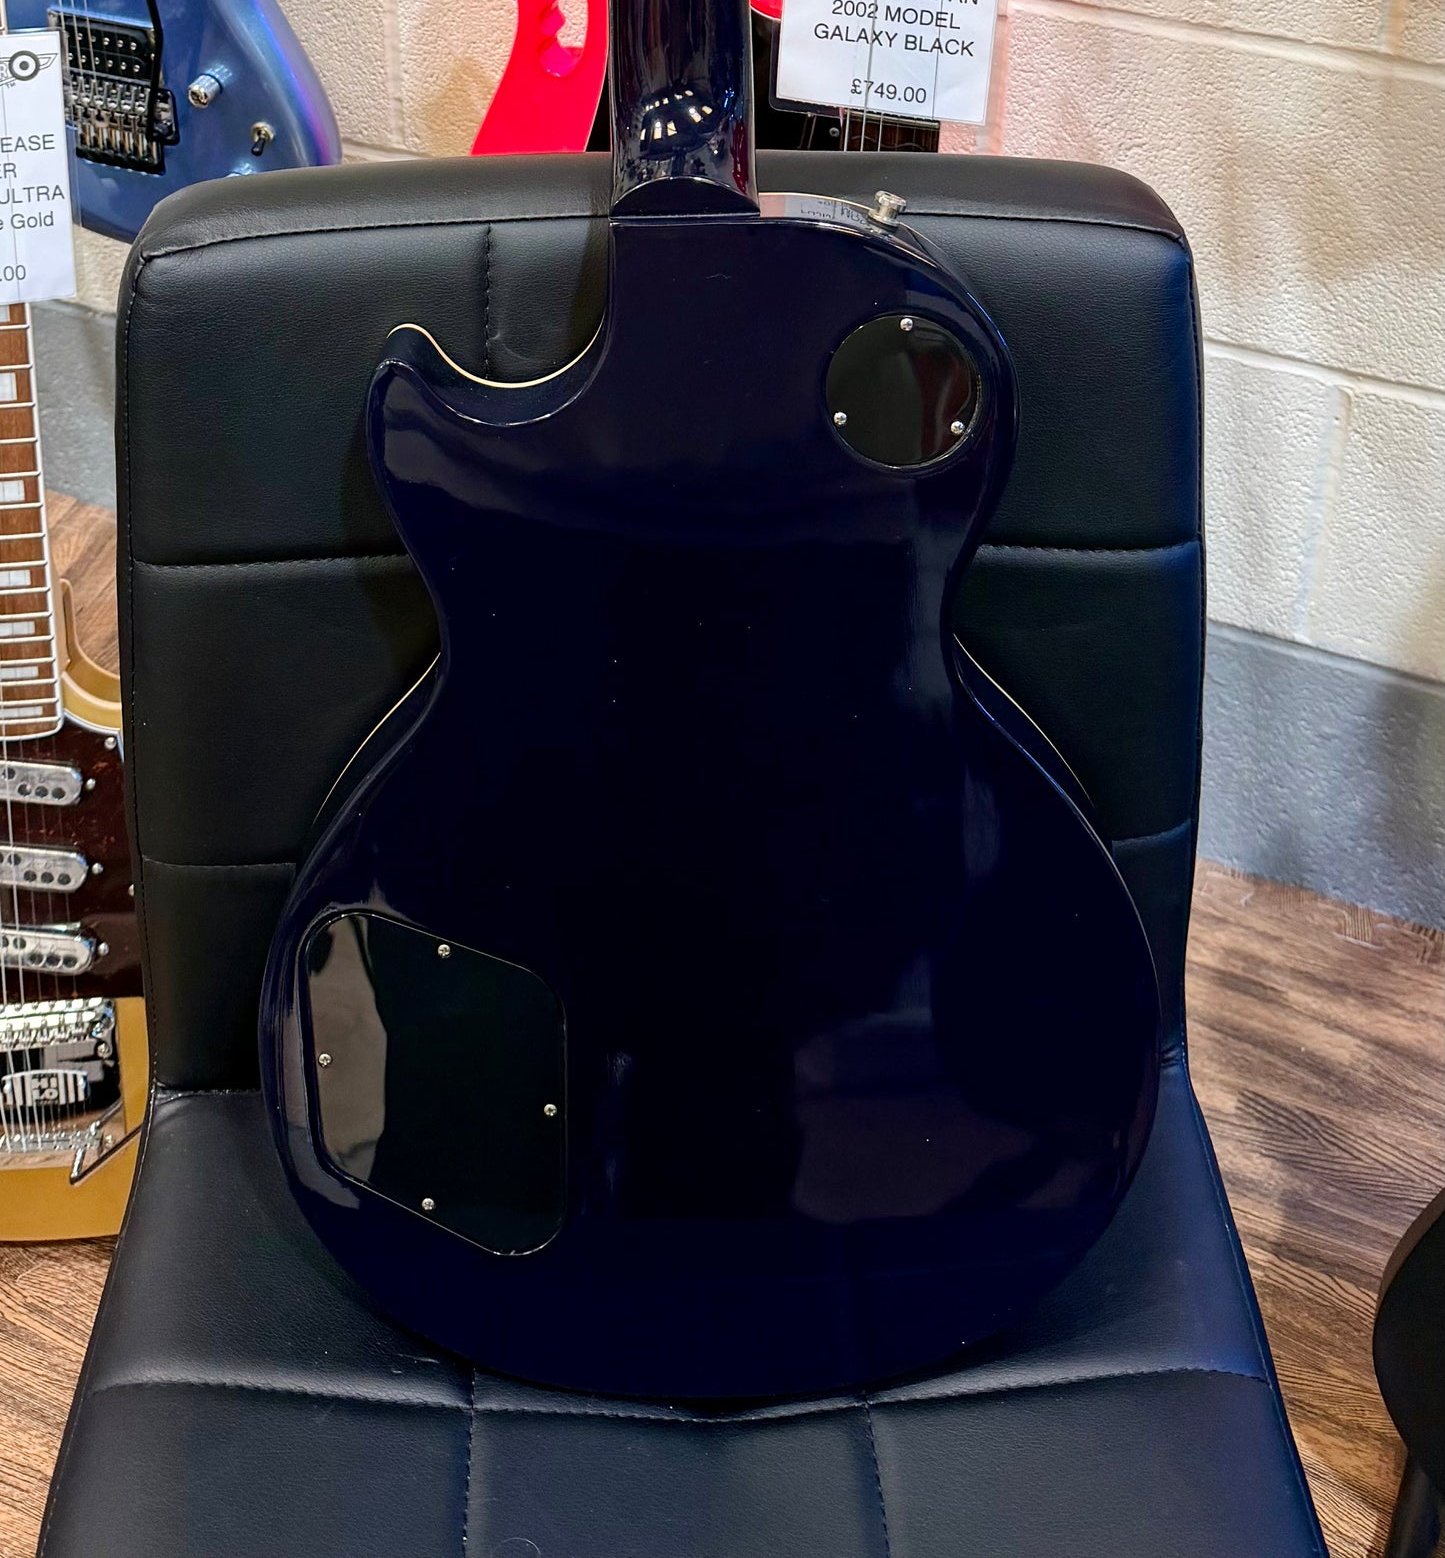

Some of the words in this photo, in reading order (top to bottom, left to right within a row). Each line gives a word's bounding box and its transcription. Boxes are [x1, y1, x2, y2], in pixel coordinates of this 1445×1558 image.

[884, 5, 961, 30] MODEL
[813, 23, 898, 48] GALAXY
[904, 34, 975, 58] BLACK
[850, 78, 927, 104] £749.00
[0, 134, 55, 153] EASE
[0, 162, 17, 179] R
[0, 185, 65, 205] ULTRA
[10, 211, 54, 230] Gold
